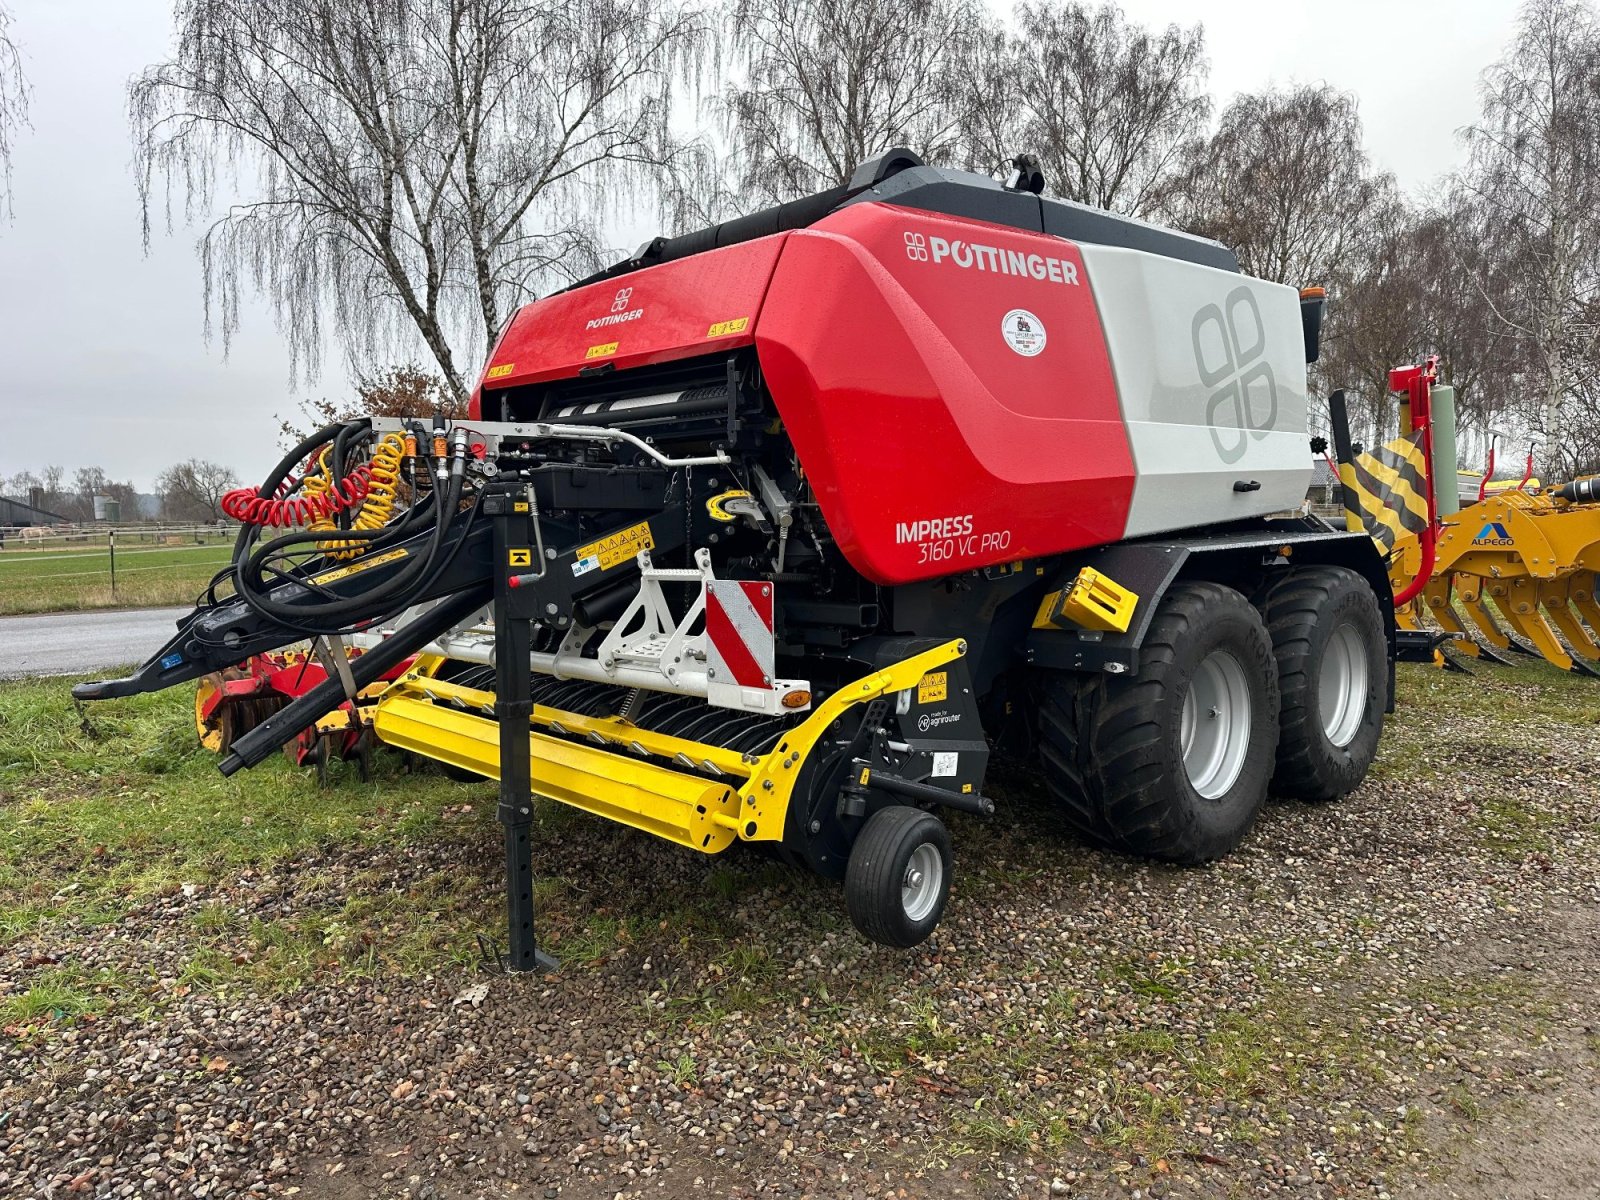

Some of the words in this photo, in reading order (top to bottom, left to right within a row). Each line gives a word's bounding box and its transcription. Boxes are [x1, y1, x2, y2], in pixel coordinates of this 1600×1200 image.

[895, 514, 973, 544] IMPRESS
[917, 539, 954, 564] 3160
[958, 535, 978, 556] VC
[980, 530, 1011, 553] PRO
[1471, 538, 1514, 546] ALPEGO
[930, 714, 960, 727] agrirouter
